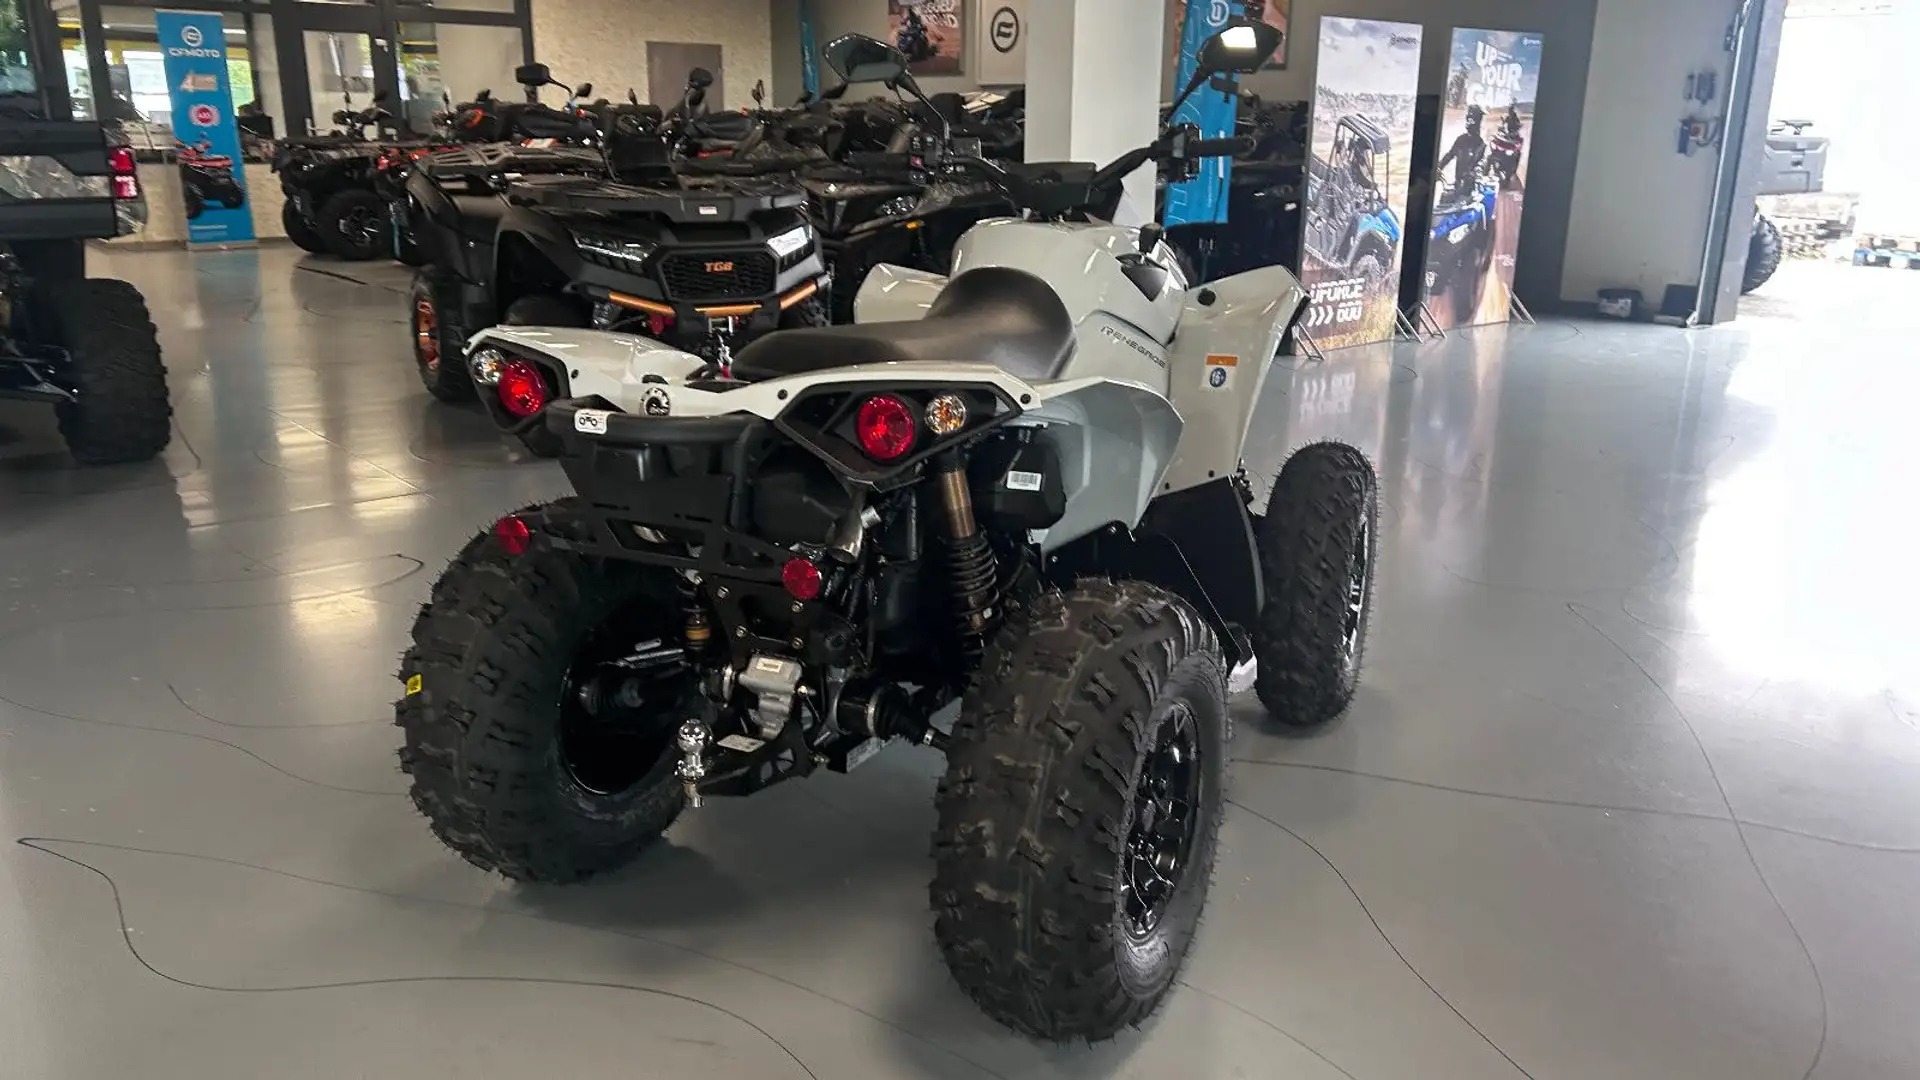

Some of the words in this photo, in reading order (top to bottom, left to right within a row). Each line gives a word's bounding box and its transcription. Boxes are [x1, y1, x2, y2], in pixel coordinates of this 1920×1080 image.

[1476, 40, 1498, 67] UP
[1480, 62, 1522, 92] YOUR
[704, 261, 734, 273] TGB
[1310, 277, 1365, 304] UFORCE
[1336, 300, 1363, 322] 600
[1100, 326, 1166, 369] RENEGADE
